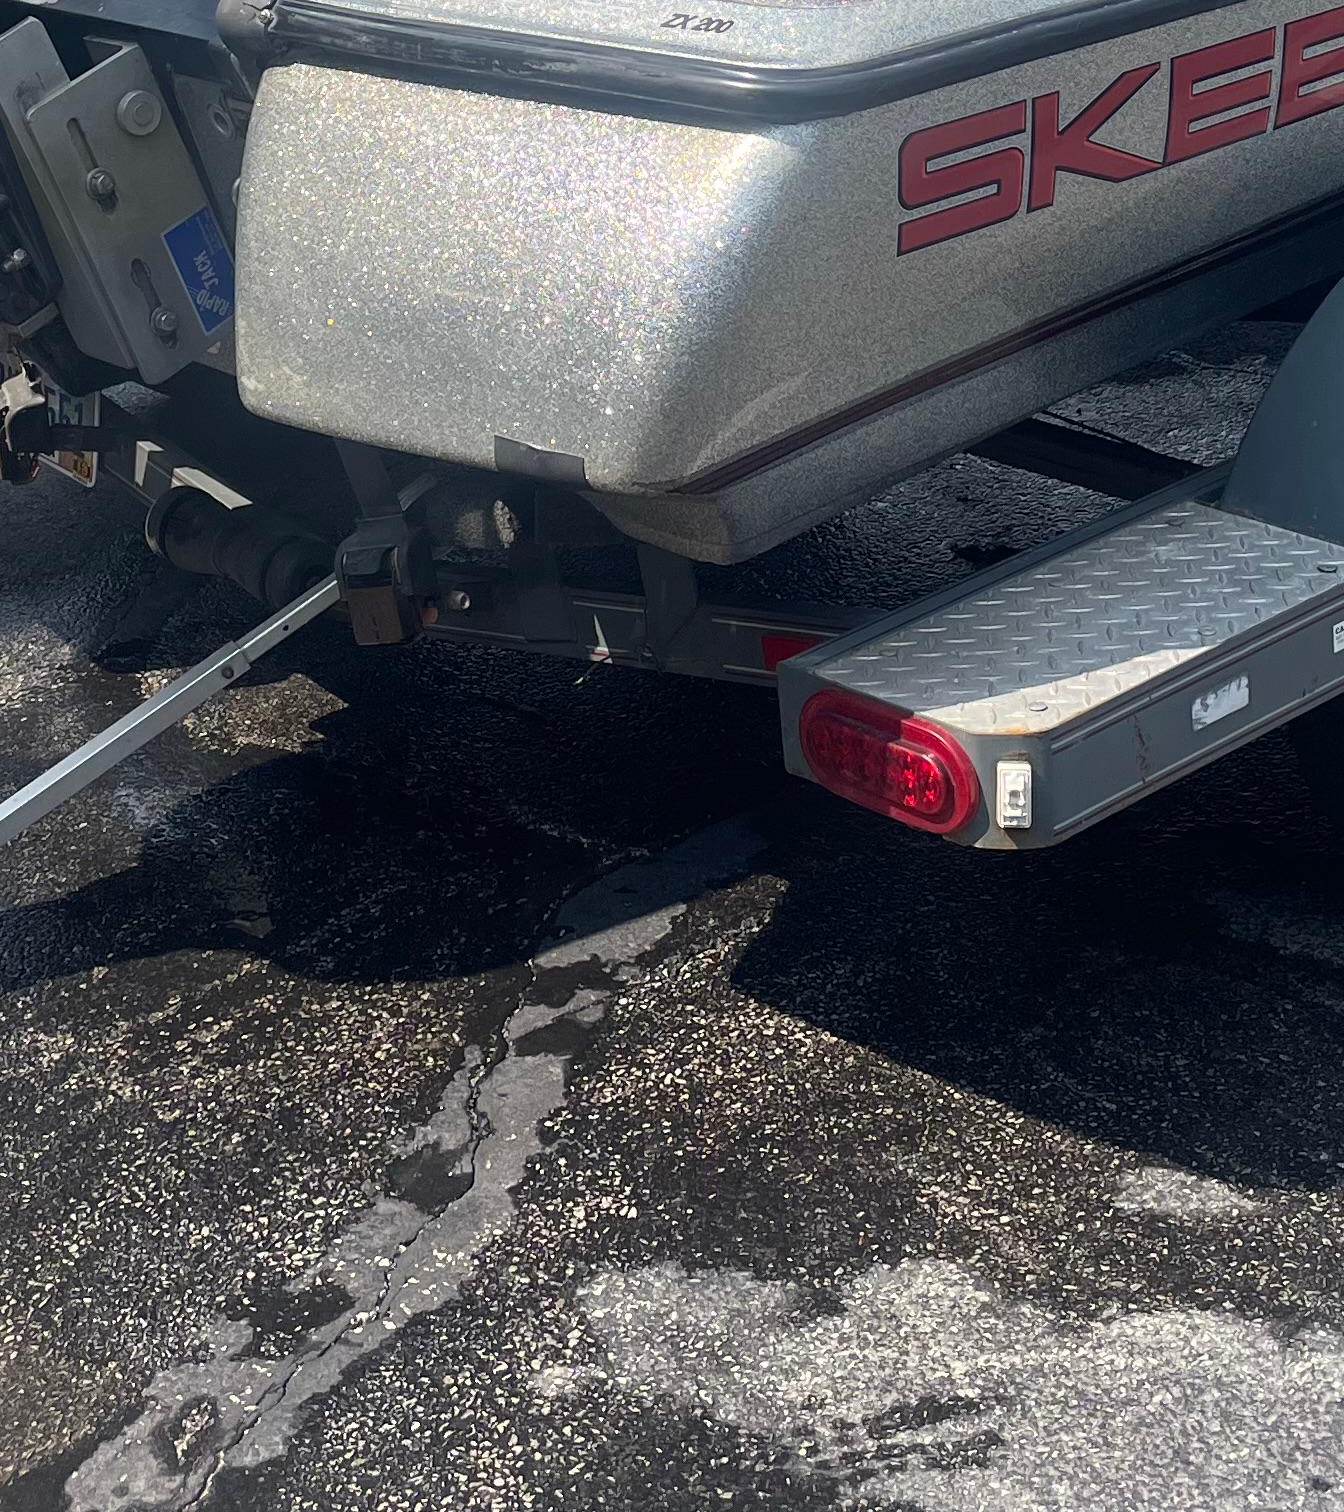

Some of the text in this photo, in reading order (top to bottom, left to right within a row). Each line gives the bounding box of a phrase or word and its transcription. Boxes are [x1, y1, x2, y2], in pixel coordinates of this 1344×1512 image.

[691, 17, 735, 33] 200
[193, 250, 219, 287] JACK
[196, 290, 230, 317] RAPID
